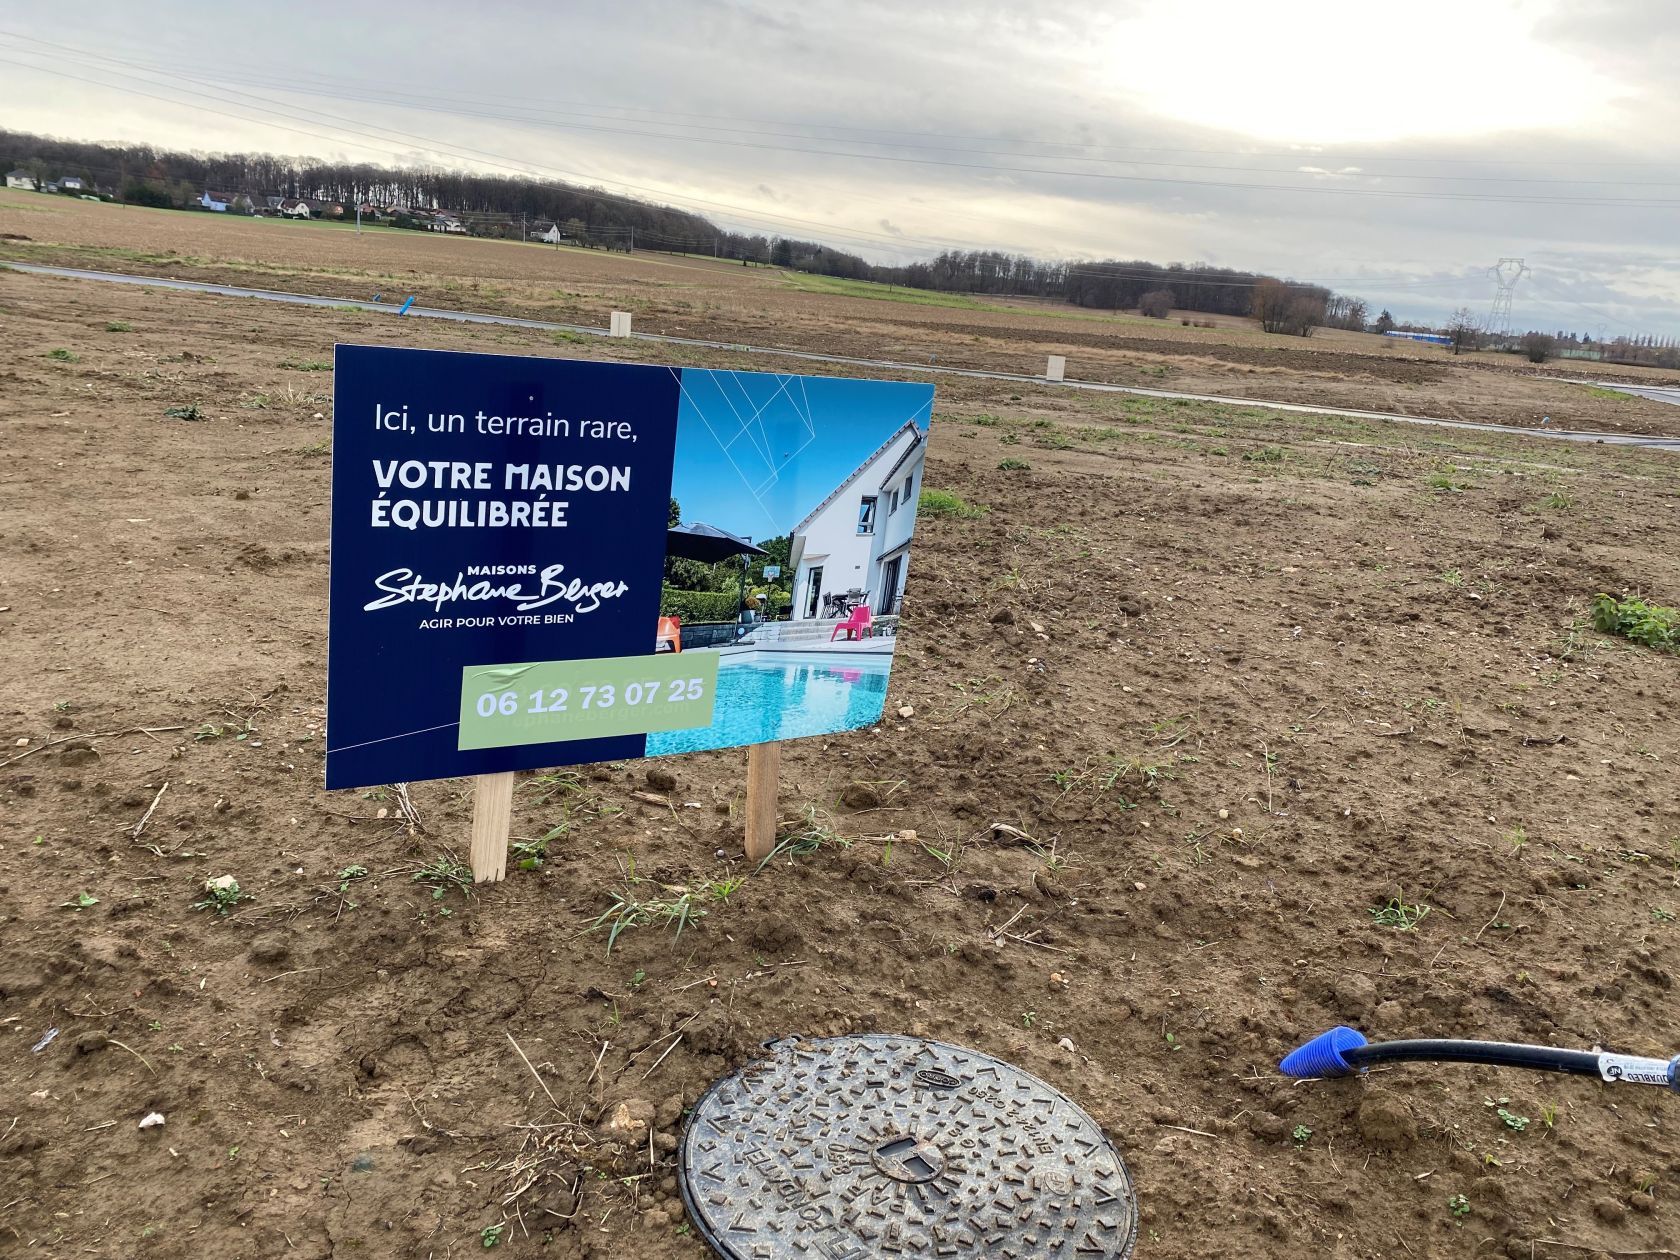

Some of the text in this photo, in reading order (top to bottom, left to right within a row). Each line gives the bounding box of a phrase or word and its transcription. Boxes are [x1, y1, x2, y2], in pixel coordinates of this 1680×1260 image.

[374, 403, 638, 444] Ici, un terrain rare,
[372, 459, 631, 493] VOTRE MAISON
[371, 490, 569, 531] ÉQUILIBRÉE
[363, 563, 629, 614] Stephane Berger
[467, 564, 537, 576] MAISONS
[418, 613, 575, 630] AGIR POUR VOTRE BIEN
[476, 691, 518, 718] 06
[527, 687, 569, 714] 12
[578, 684, 616, 710] 73
[623, 681, 661, 706] 07
[667, 677, 704, 703] 25
[1628, 1072, 1670, 1085] QUABLEU
